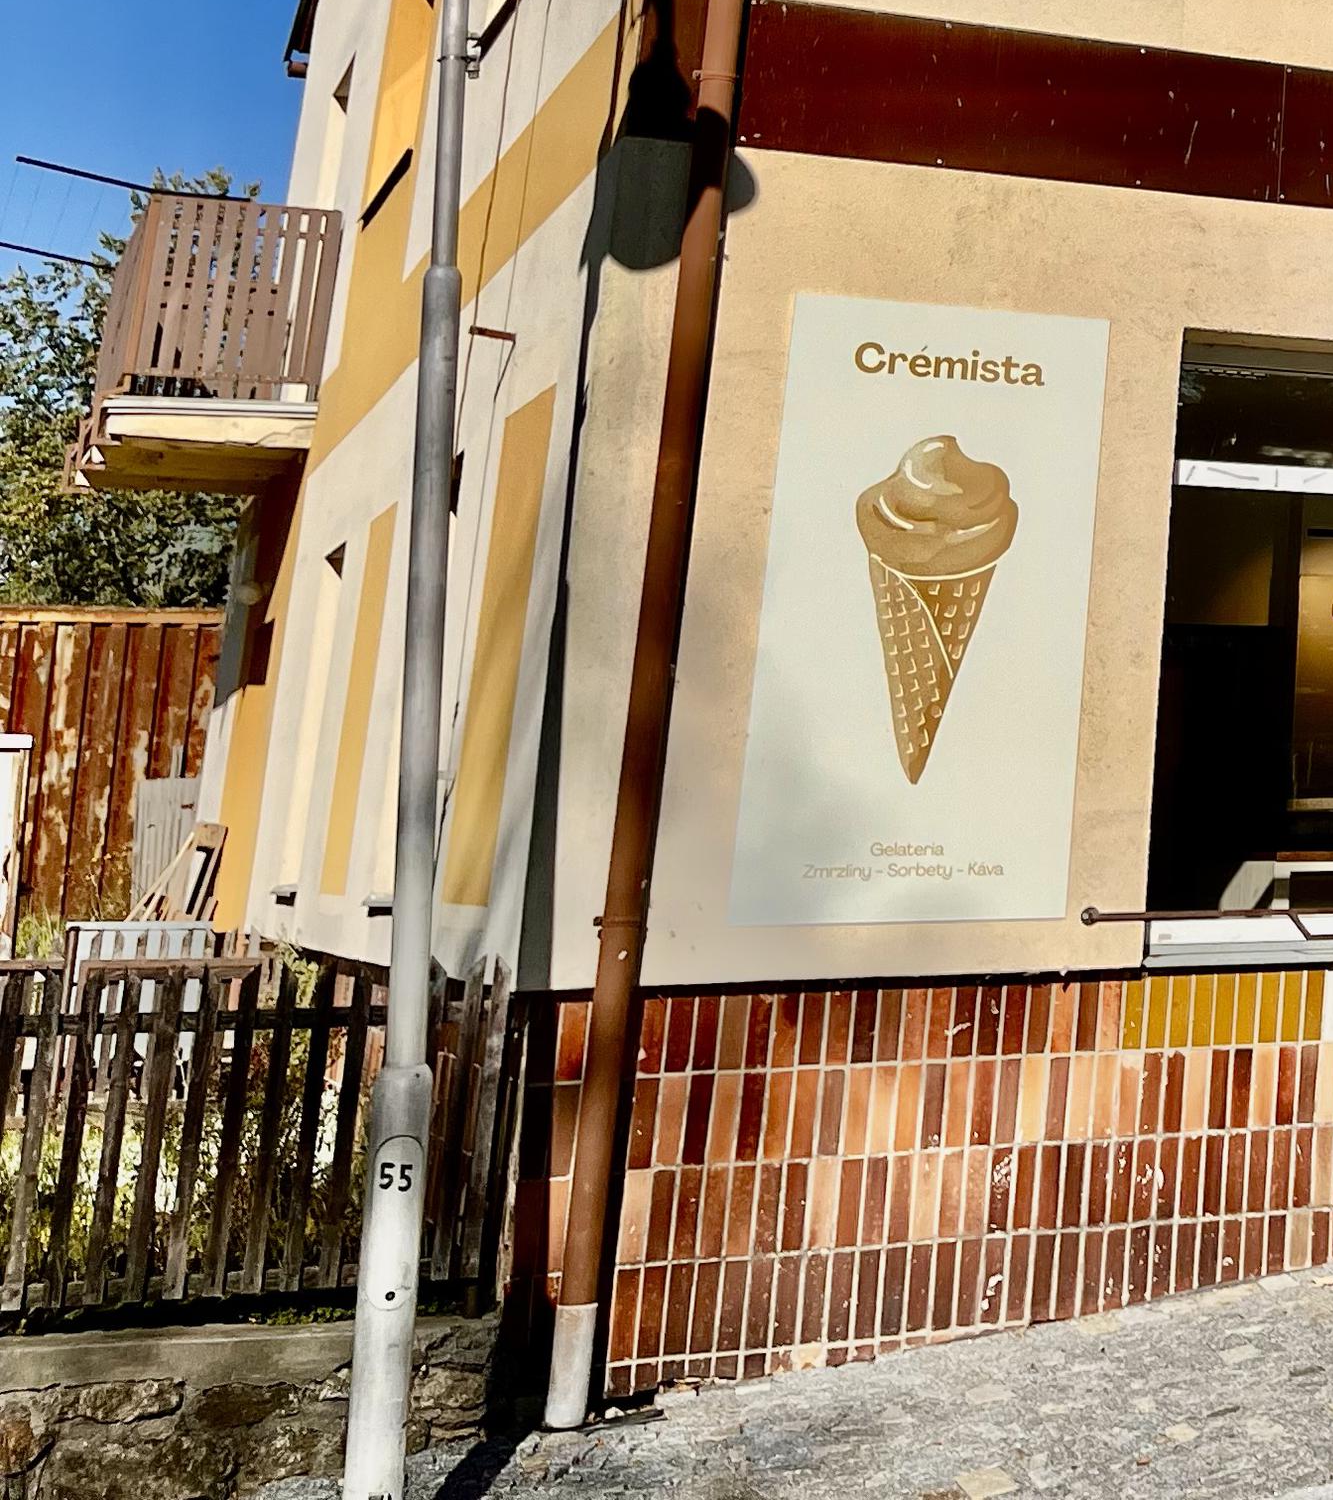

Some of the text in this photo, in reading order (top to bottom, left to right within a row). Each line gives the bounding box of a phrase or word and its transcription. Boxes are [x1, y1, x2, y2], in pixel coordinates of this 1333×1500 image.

[854, 342, 1045, 387] Crémista
[870, 841, 945, 857] Gelateria
[802, 864, 872, 882] Zmrzliny
[887, 862, 953, 881] Sorbety
[967, 860, 1005, 876] Káva
[379, 1162, 413, 1192] 55
